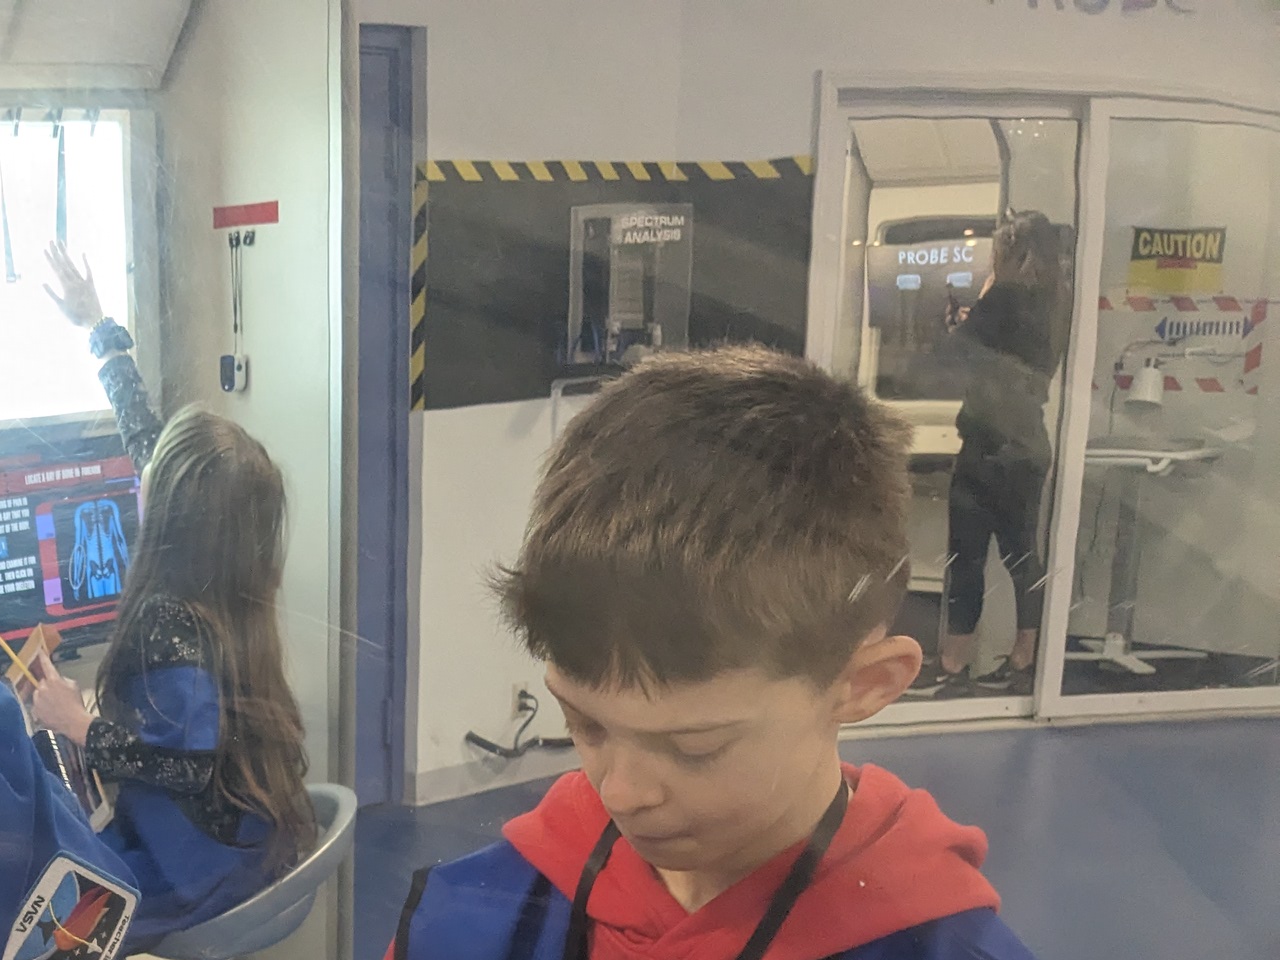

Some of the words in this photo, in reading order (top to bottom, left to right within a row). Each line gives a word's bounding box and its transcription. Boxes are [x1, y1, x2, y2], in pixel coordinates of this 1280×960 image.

[898, 246, 948, 265] PROBE
[1139, 231, 1220, 259] CAUTION
[107, 915, 130, 955] Teacher
